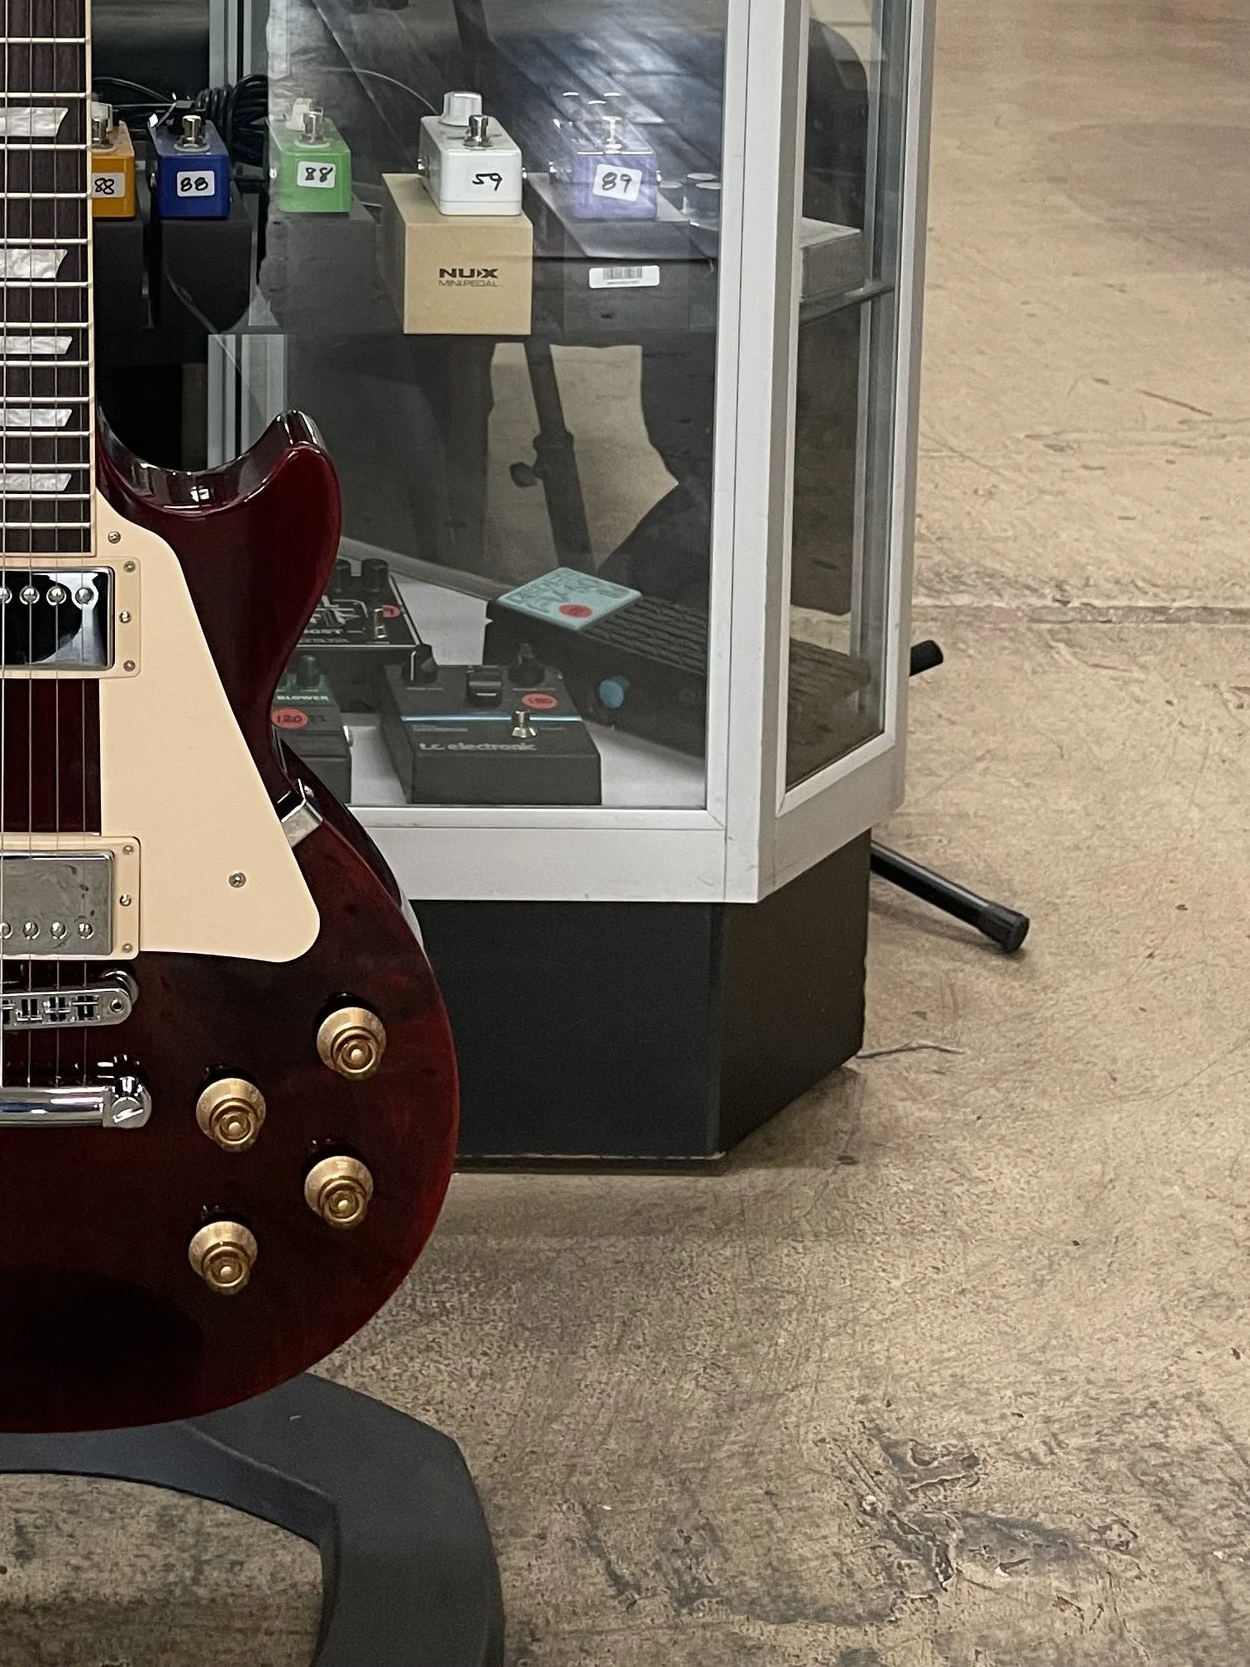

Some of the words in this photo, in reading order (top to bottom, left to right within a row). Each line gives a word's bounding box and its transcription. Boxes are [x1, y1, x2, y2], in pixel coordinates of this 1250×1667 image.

[93, 177, 116, 196] 88
[470, 171, 504, 192] 59
[601, 171, 634, 195] 89
[438, 267, 500, 279] NUX
[463, 279, 499, 288] PEDAL
[447, 742, 538, 752] electronic
